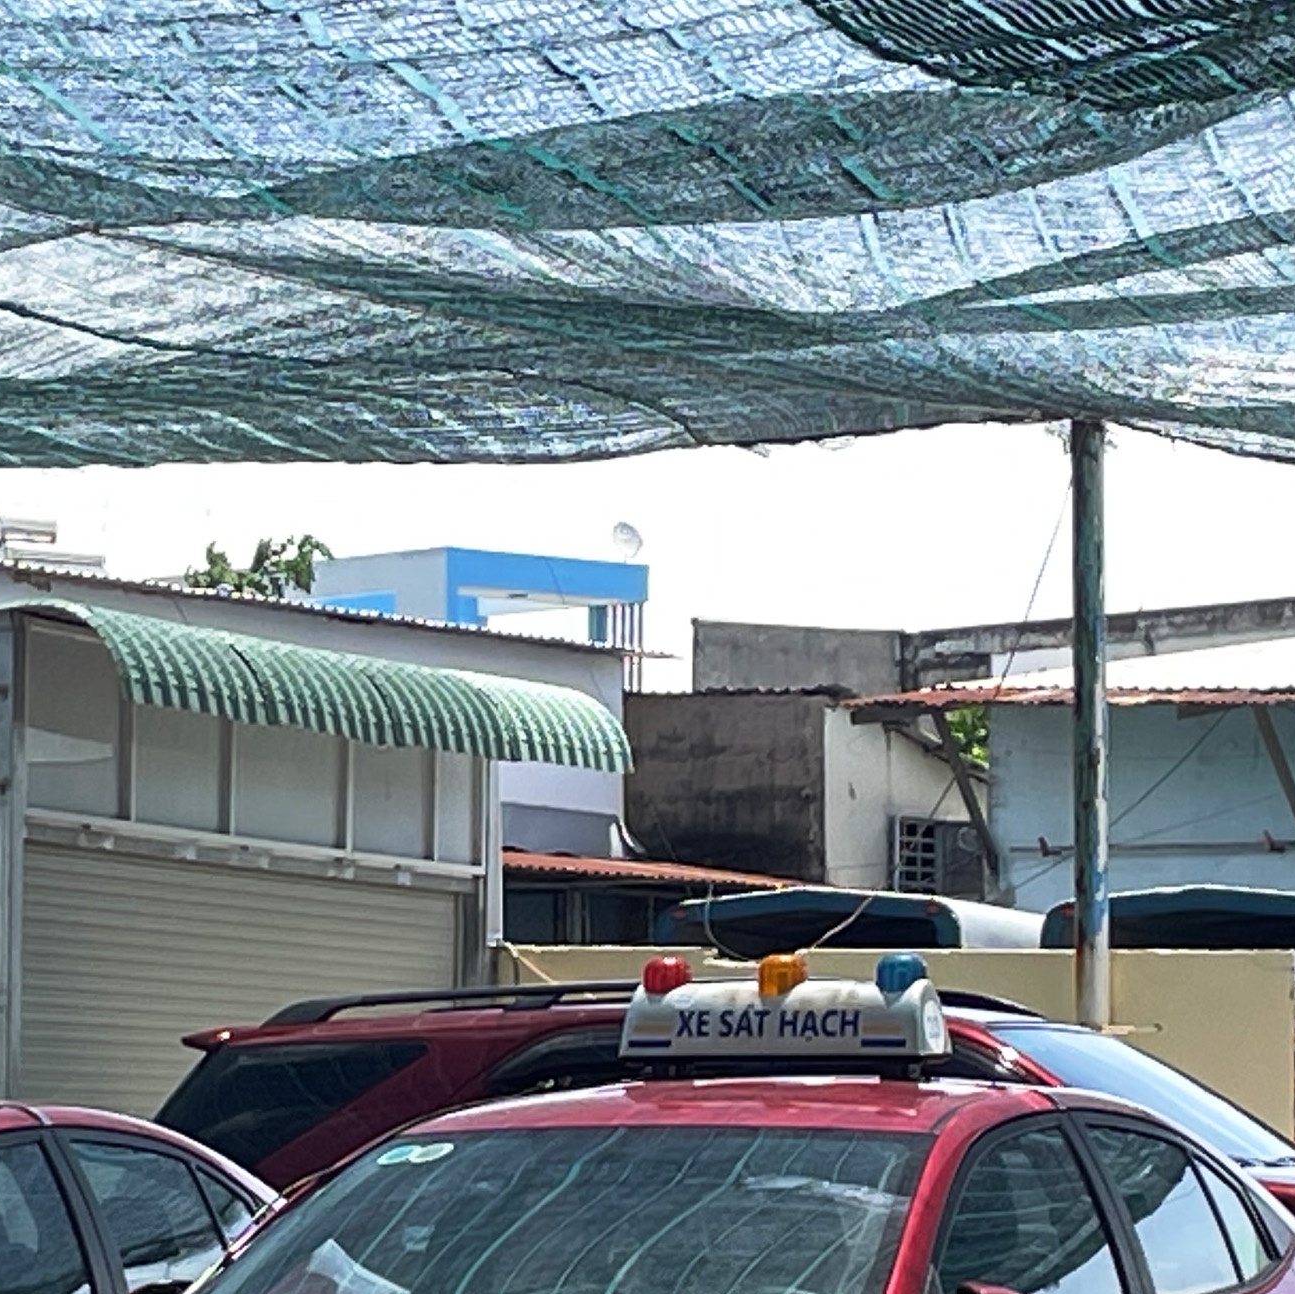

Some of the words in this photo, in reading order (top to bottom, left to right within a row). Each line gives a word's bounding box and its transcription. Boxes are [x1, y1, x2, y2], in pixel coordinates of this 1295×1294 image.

[676, 1009, 710, 1038] XE
[718, 1003, 771, 1038] SÁT
[779, 1008, 860, 1041] HẠCH
